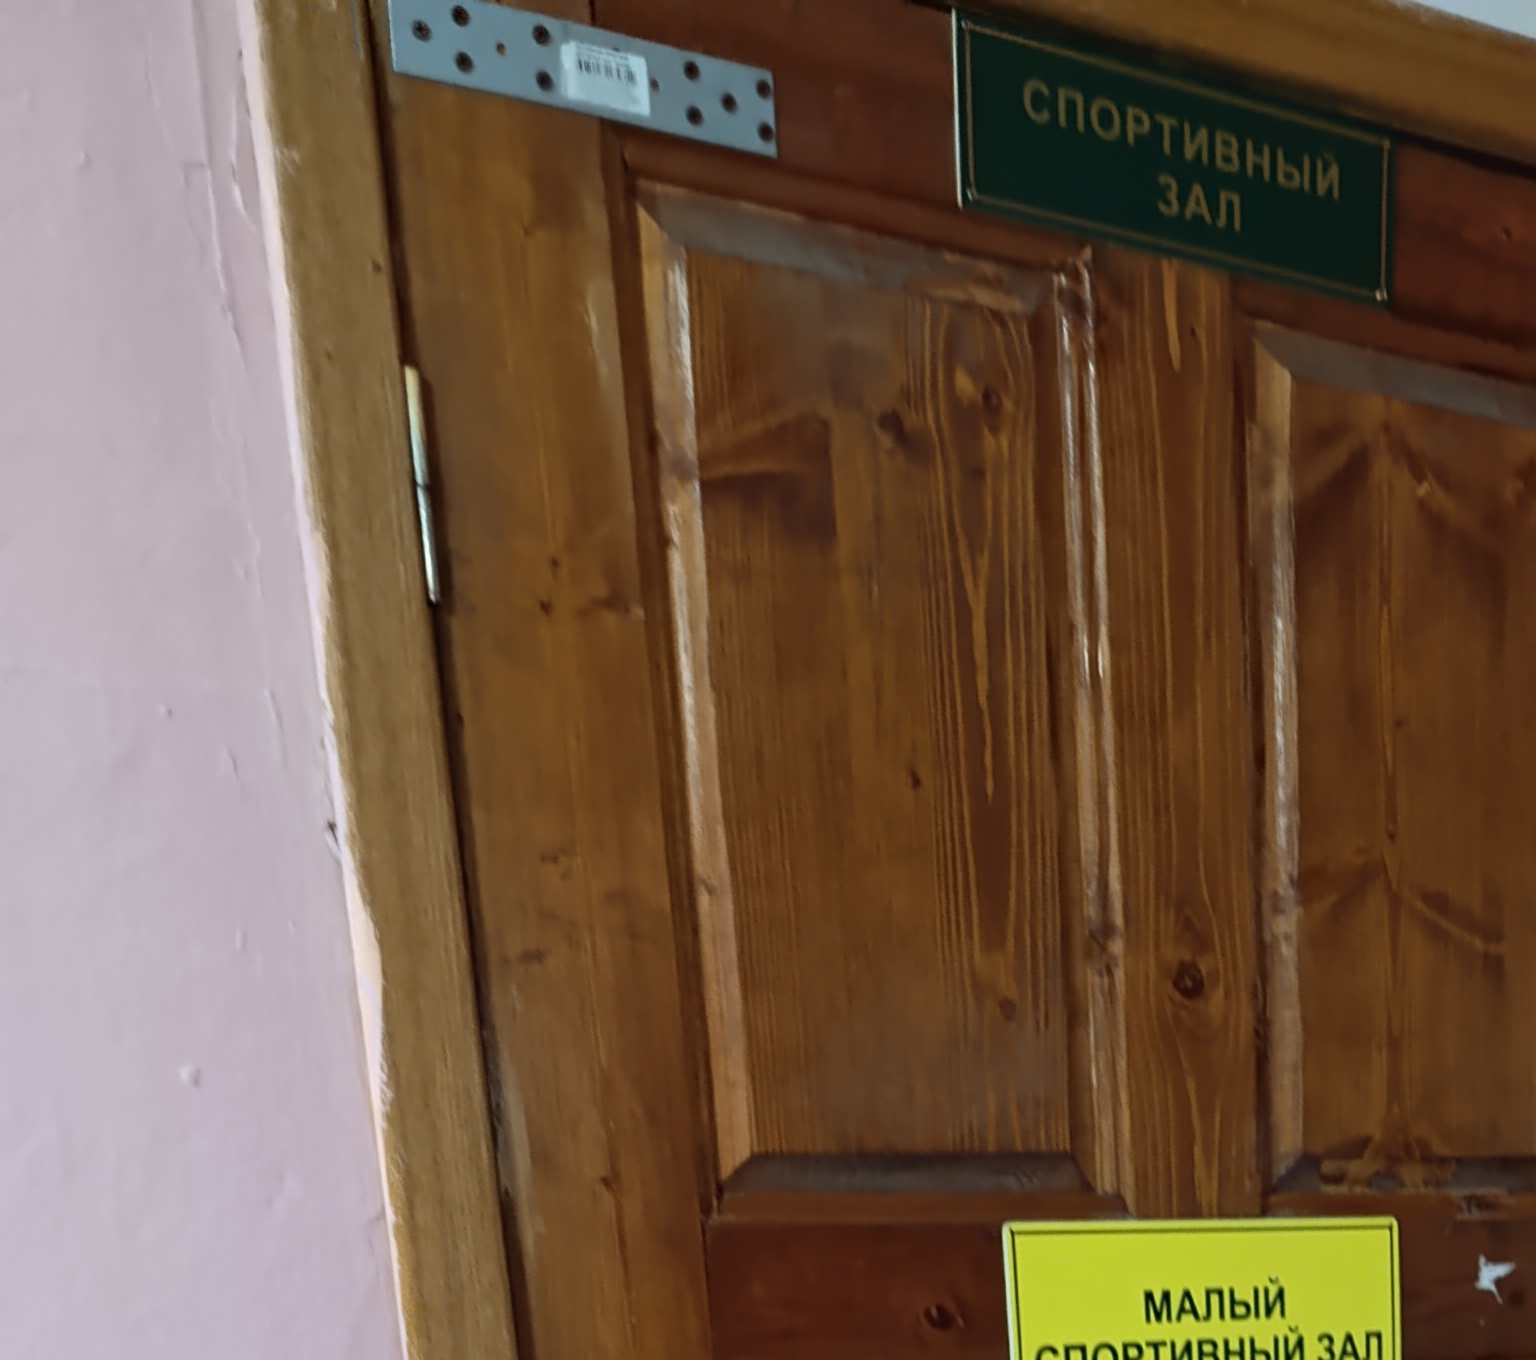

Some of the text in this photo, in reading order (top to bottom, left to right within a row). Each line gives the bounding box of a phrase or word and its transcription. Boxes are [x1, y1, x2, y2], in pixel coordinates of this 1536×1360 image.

[1023, 77, 1340, 202] СПОРТИВНЫЙ
[1157, 173, 1241, 233] ЗАЛ
[1143, 1276, 1286, 1324] МАЛЫЙ
